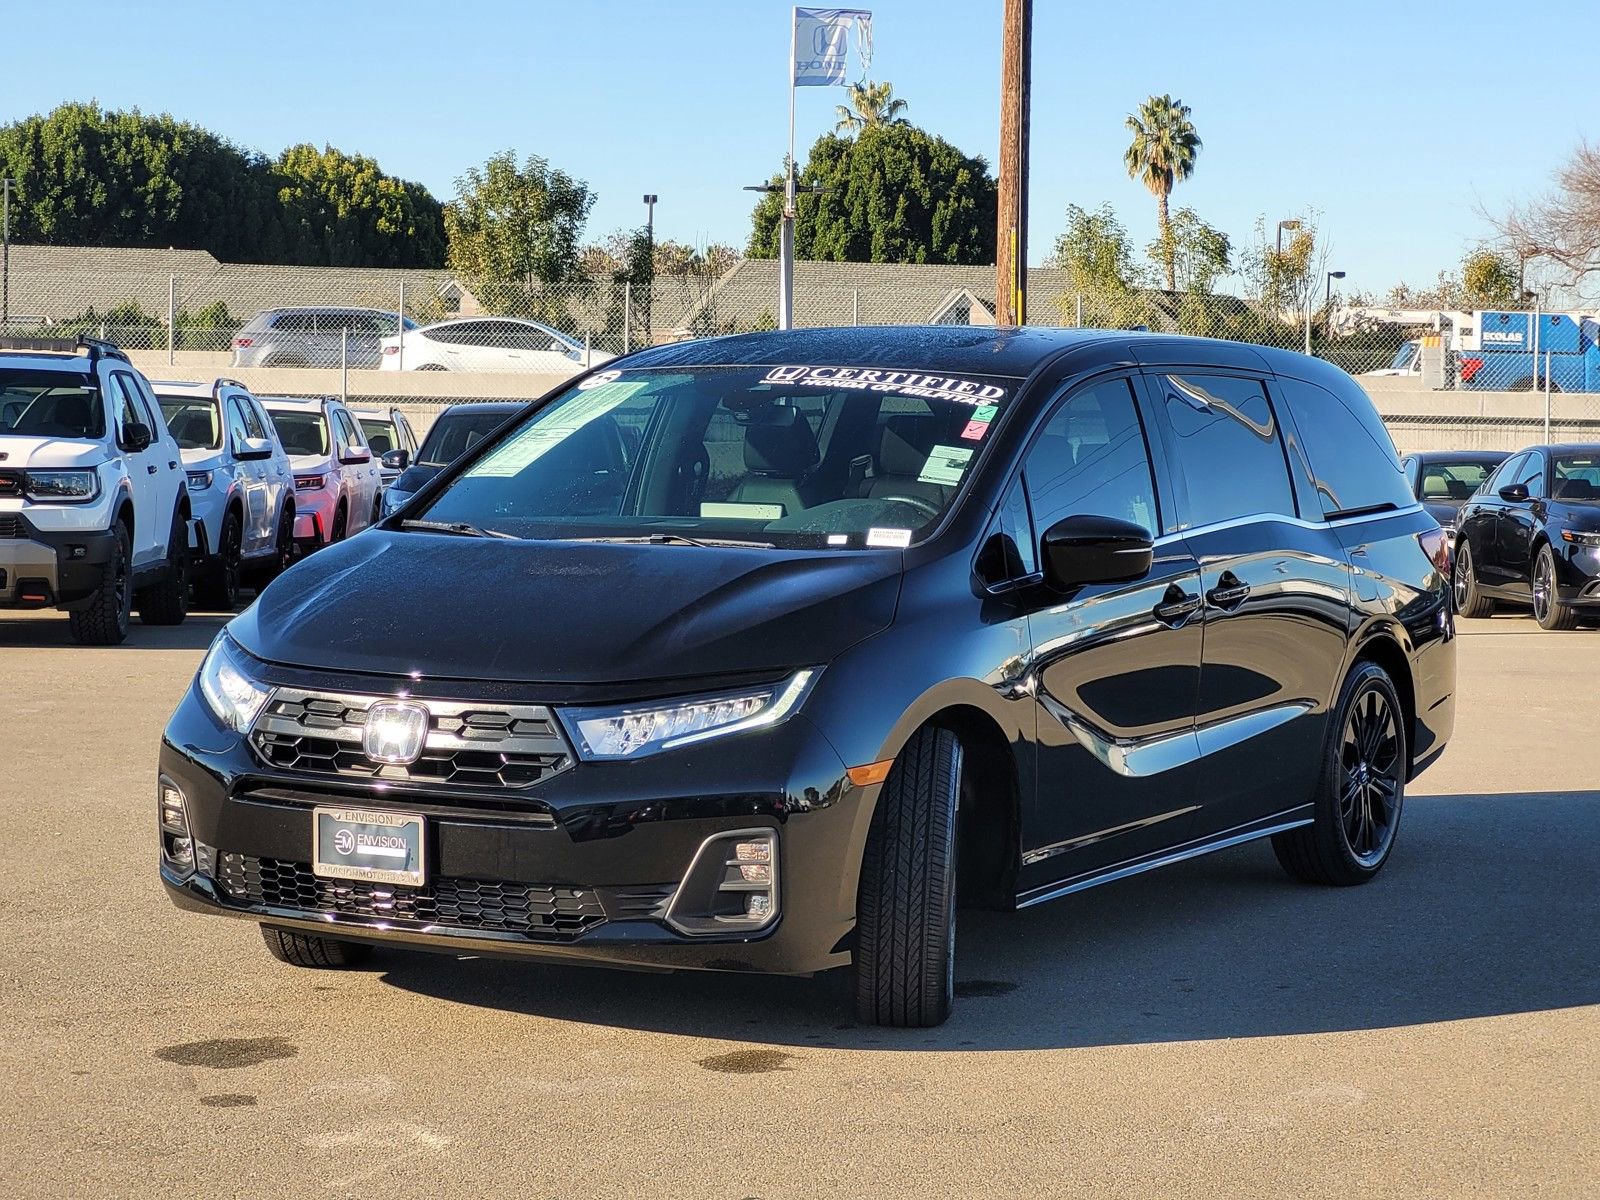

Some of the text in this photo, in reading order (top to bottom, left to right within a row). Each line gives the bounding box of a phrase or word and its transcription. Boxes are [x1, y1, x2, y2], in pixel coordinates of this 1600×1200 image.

[800, 379, 992, 406] HONDA OF MILPITAS
[810, 367, 1005, 399] CERTIFIED
[345, 811, 393, 825] ENVISION
[357, 833, 407, 849] ENVISION
